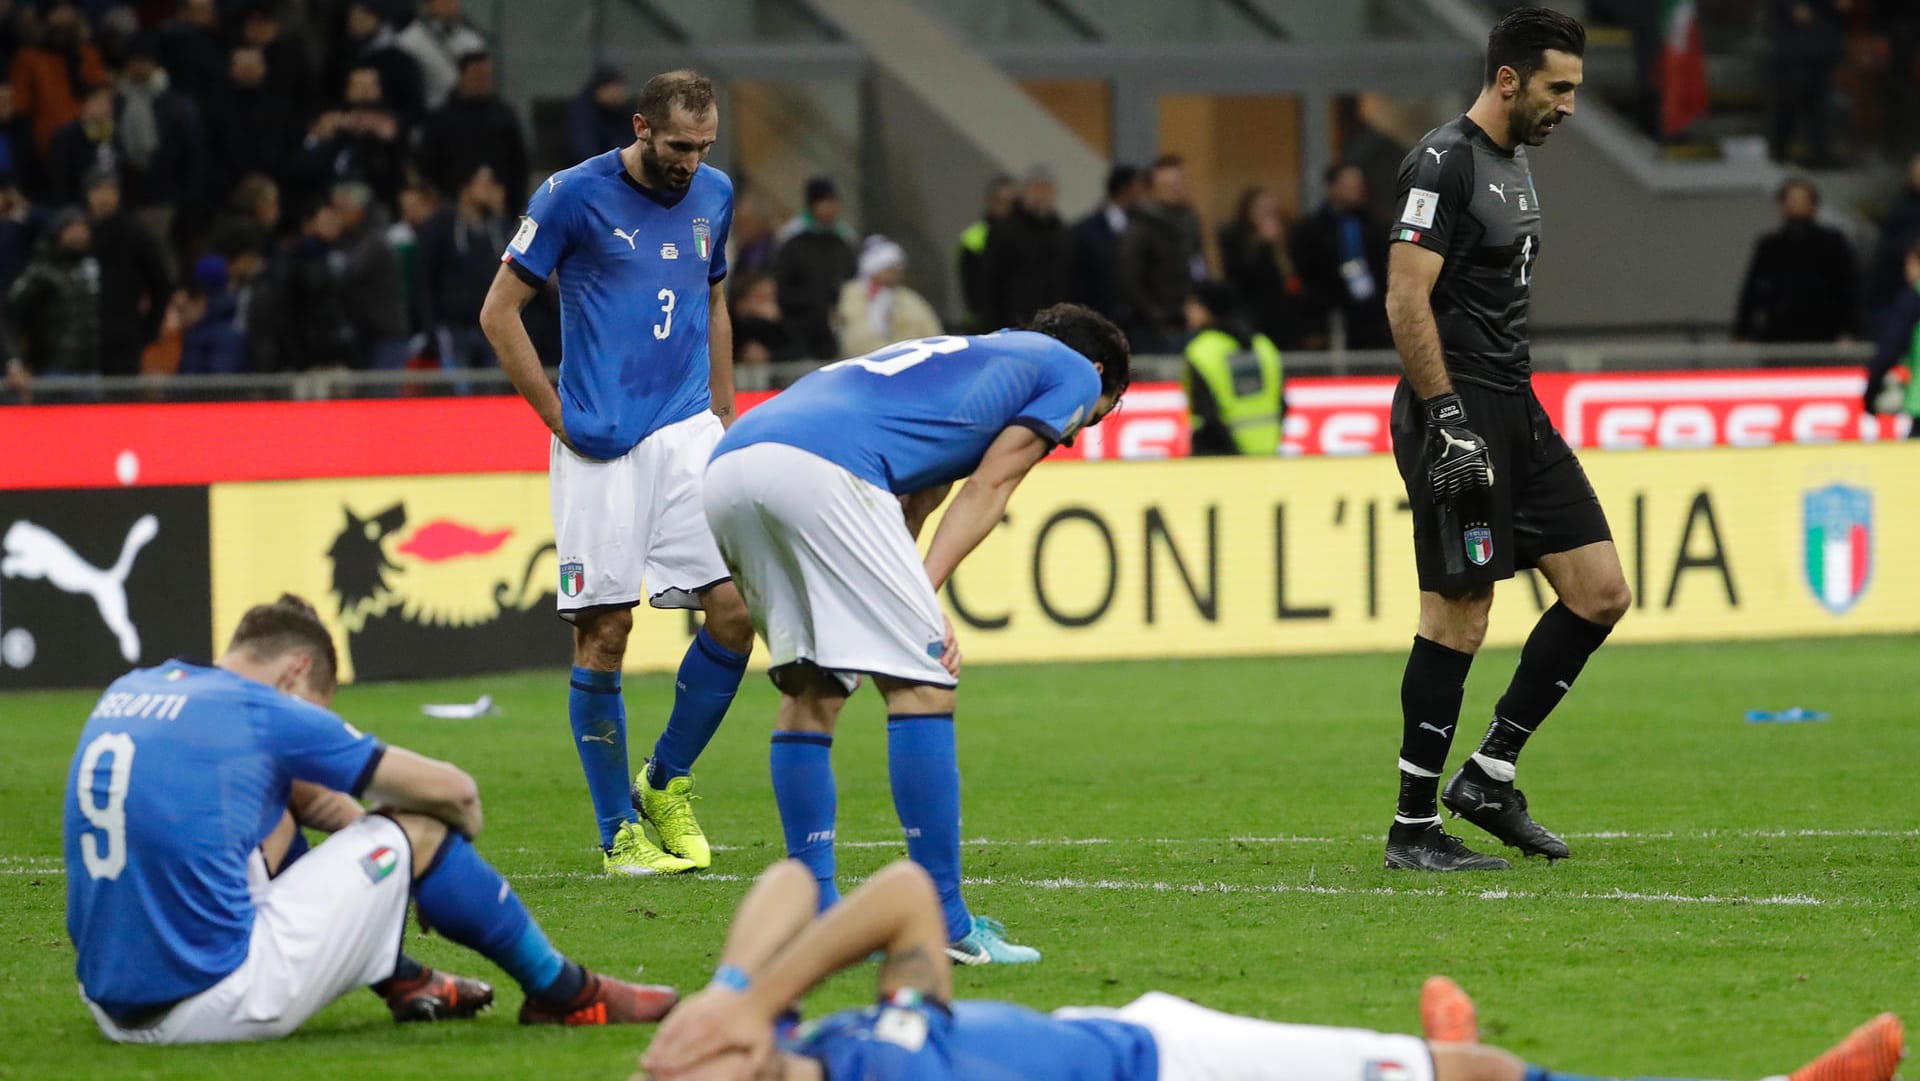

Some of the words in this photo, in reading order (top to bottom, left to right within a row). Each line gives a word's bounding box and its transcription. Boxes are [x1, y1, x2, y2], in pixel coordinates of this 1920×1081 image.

[1521, 235, 1532, 285] 1
[653, 288, 676, 340] 3
[1274, 490, 1738, 619] L'IIA
[77, 731, 136, 881] 9
